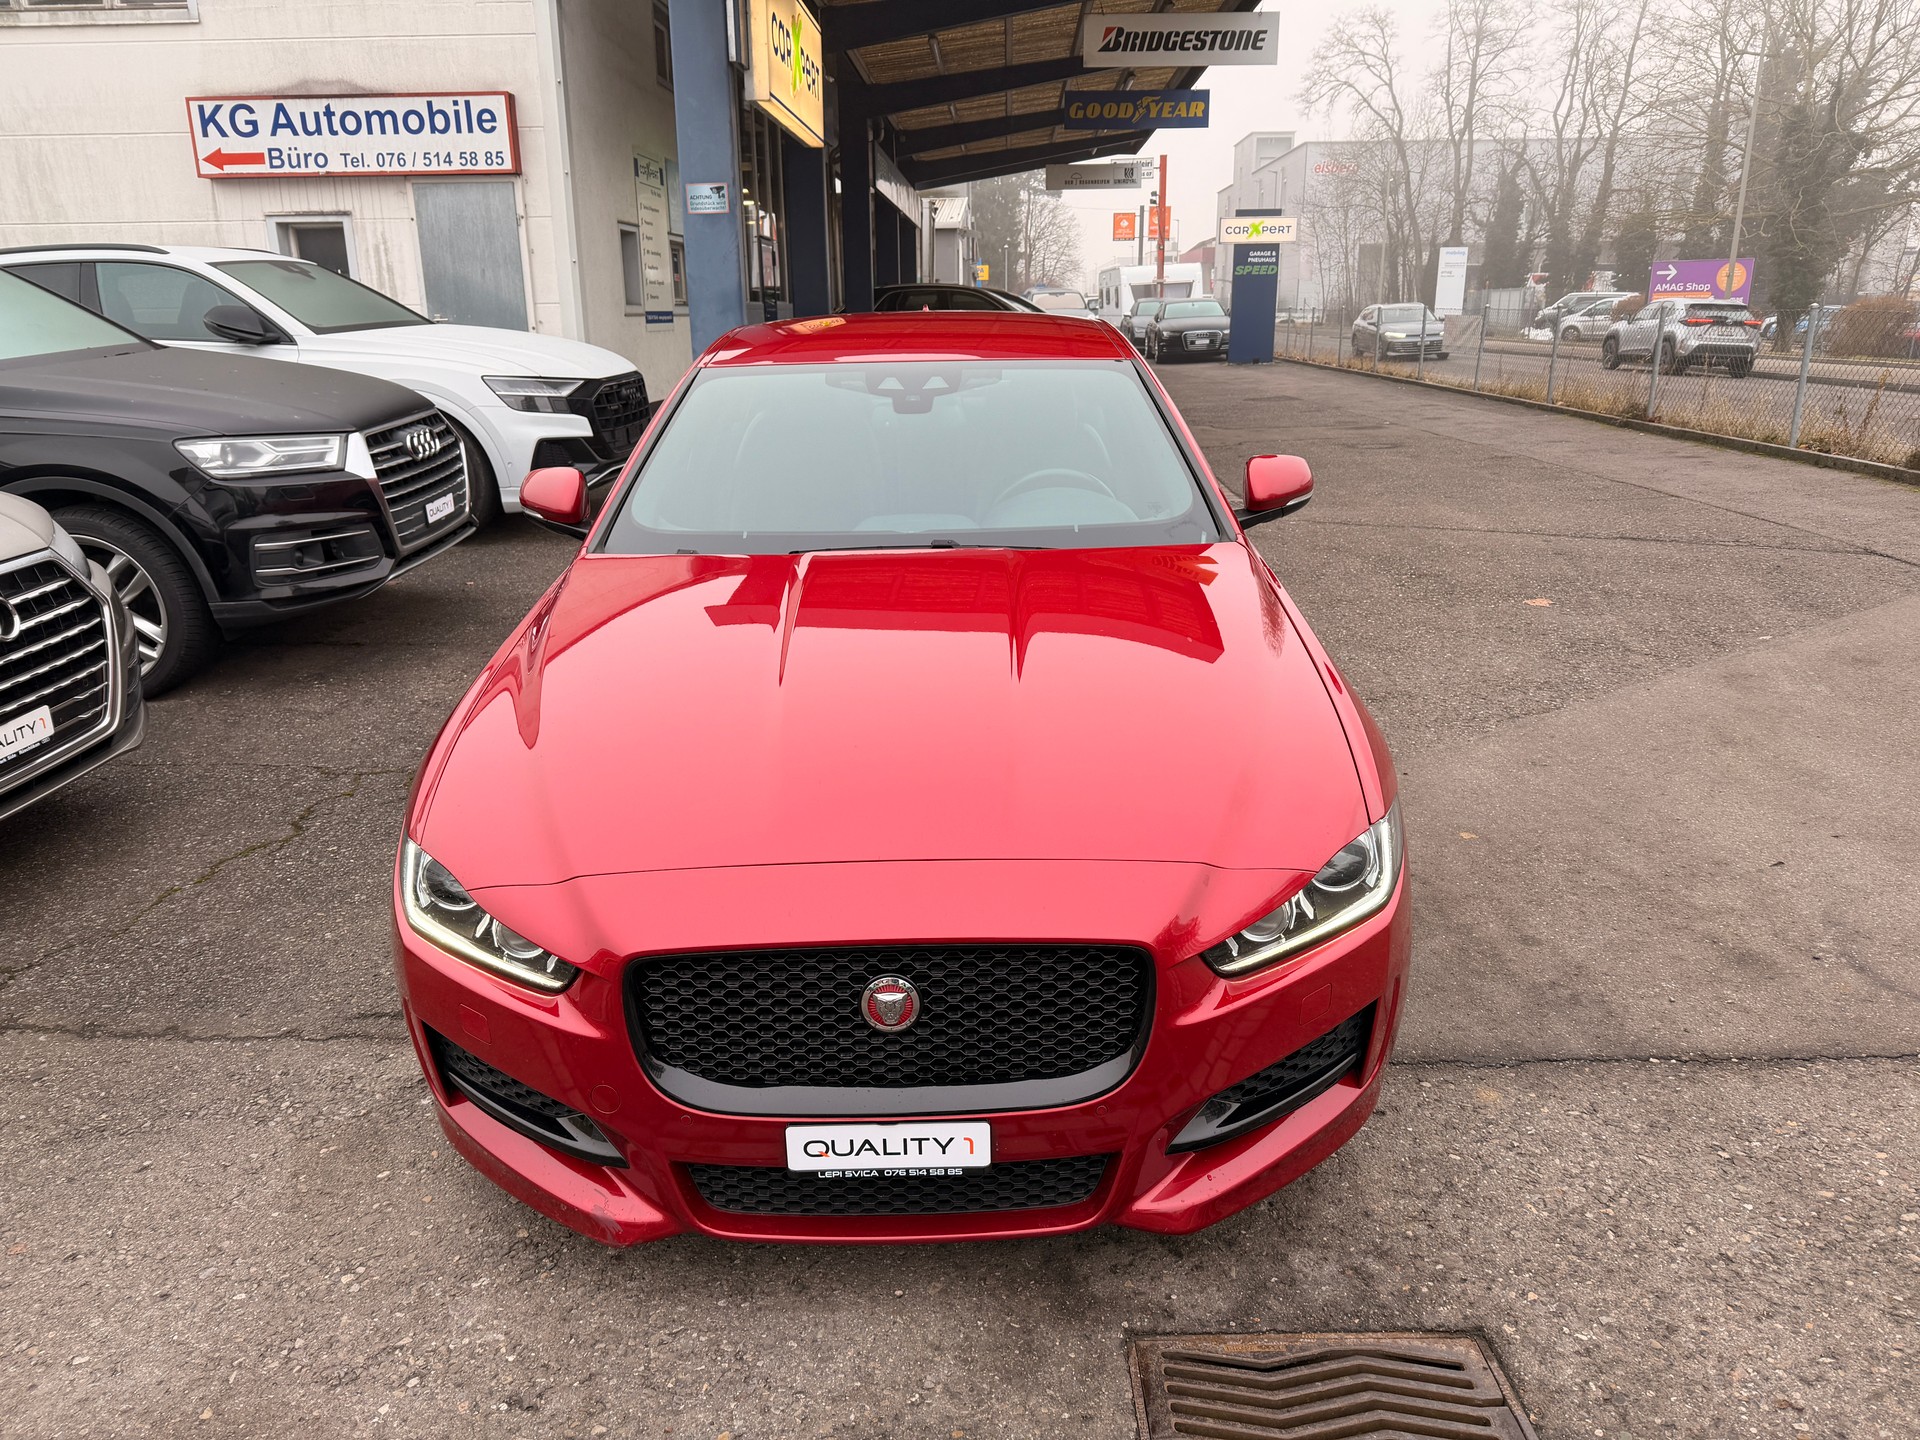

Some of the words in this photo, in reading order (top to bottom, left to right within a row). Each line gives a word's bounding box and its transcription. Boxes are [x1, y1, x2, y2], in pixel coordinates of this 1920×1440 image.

[1097, 26, 1268, 53] BRIDGESTONE
[197, 103, 259, 139] KG
[270, 99, 498, 137] Automobile
[266, 147, 329, 170] Büro
[340, 152, 371, 168] Tel.
[376, 151, 407, 168] 076
[411, 151, 417, 168] /
[422, 151, 453, 167] 514
[459, 151, 479, 167] 58
[484, 150, 505, 167] 85
[1234, 265, 1278, 275] SPEED
[1654, 283, 1684, 292] AMAG
[1685, 282, 1711, 292] Shop
[429, 502, 450, 517] QUALITY
[803, 1136, 955, 1158] QUALITY
[963, 1136, 974, 1155] 1
[818, 1170, 843, 1178] LEPI
[845, 1169, 879, 1178] SVICA
[884, 1168, 907, 1176] 076
[908, 1168, 927, 1176] 514
[947, 1167, 963, 1175] 85
